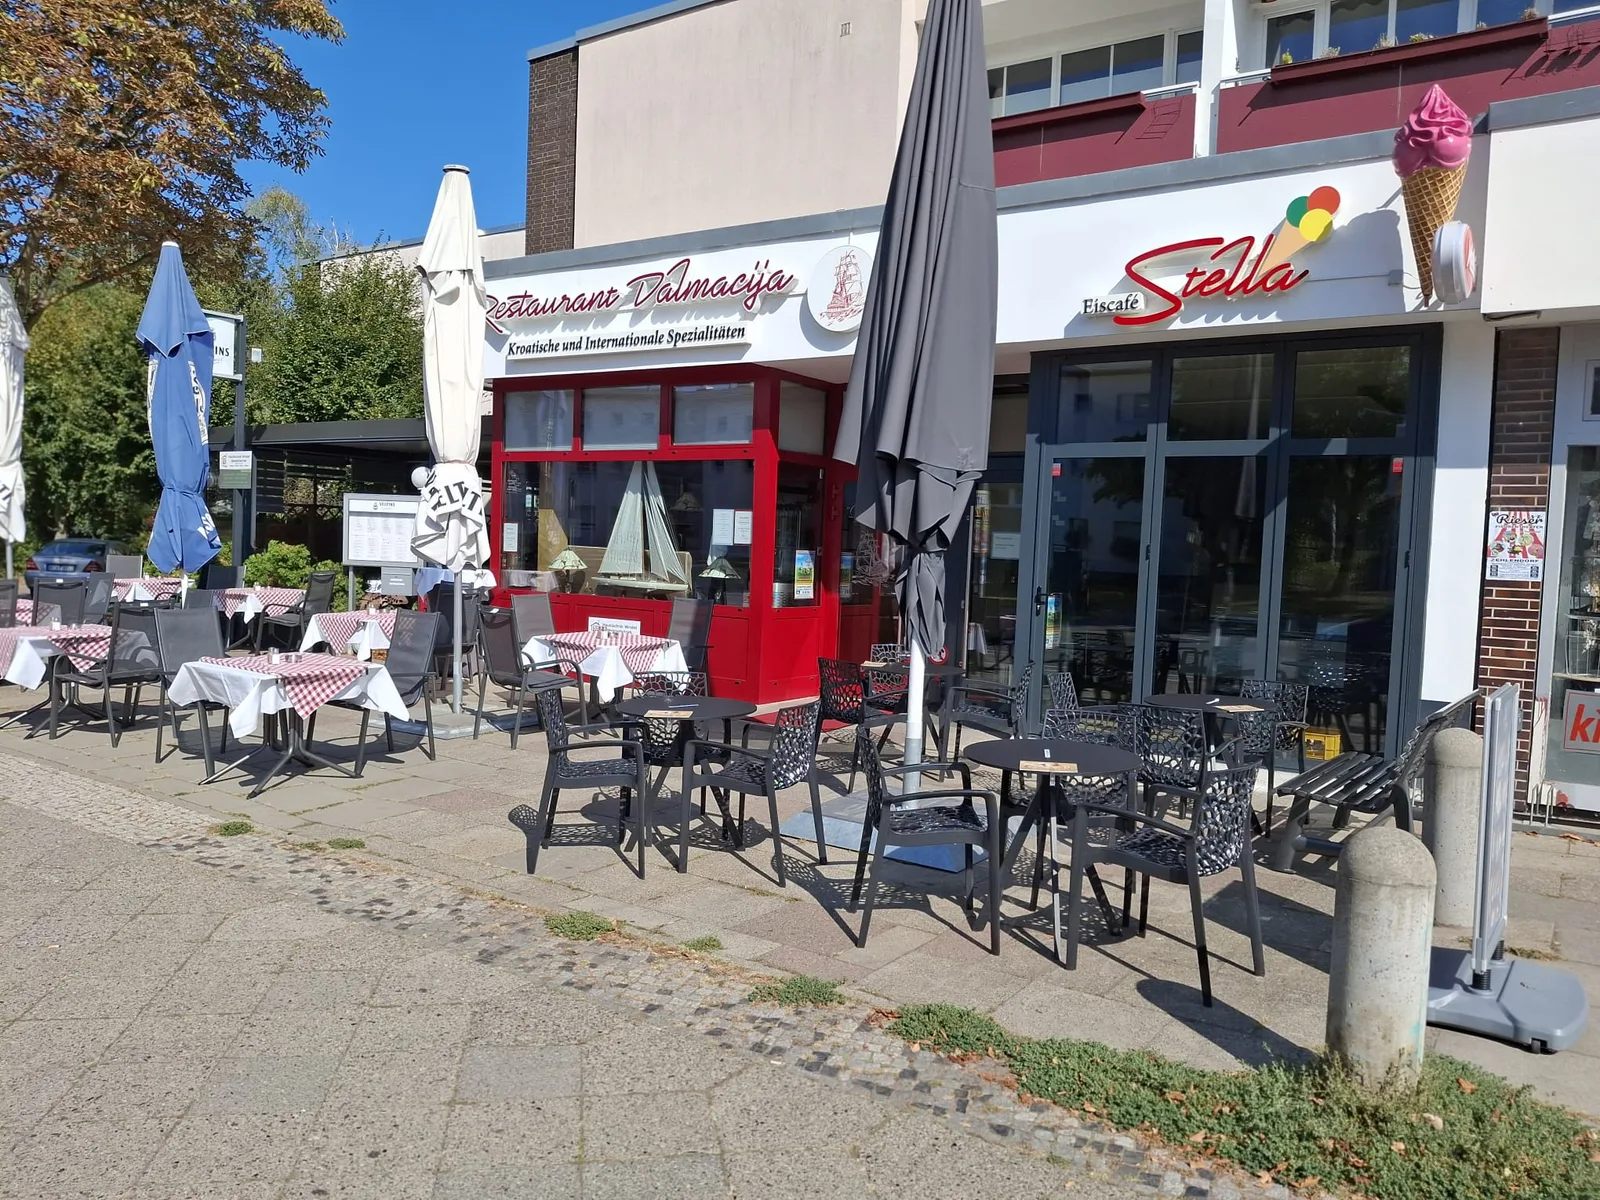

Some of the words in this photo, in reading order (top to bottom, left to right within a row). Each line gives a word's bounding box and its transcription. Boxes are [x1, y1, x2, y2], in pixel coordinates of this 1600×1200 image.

[626, 258, 794, 311] Dalmacija
[1083, 293, 1139, 313] Eiscafé
[1113, 233, 1309, 326] Stella
[214, 346, 230, 356] INS
[508, 339, 560, 356] Kroatische
[562, 336, 583, 351] und
[585, 329, 664, 350] Internationale
[666, 325, 746, 347] Spezialitäten
